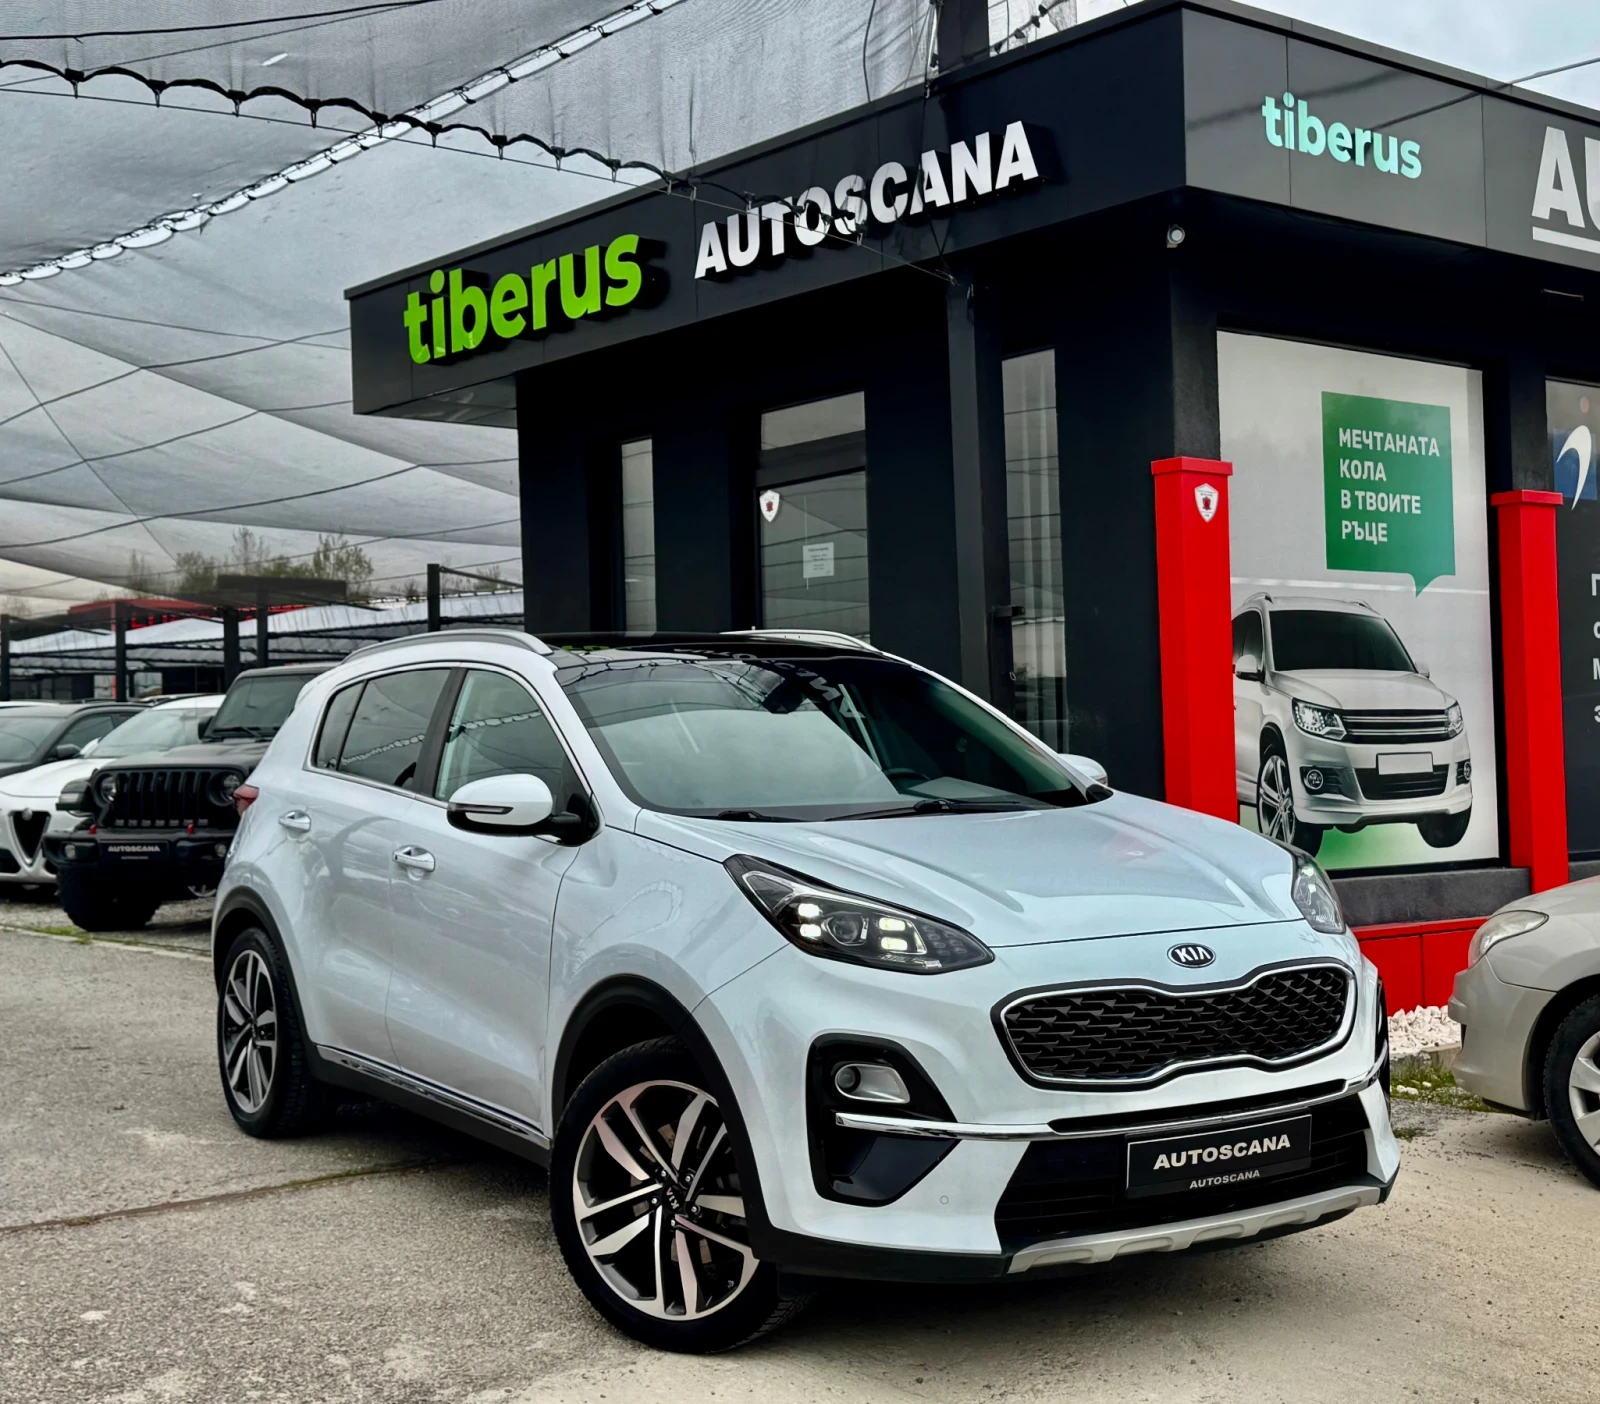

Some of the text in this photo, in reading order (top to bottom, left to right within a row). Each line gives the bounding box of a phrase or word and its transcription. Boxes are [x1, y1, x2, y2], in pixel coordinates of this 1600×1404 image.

[1262, 92, 1422, 179] tiberus
[694, 120, 1038, 279] AUTOSCANA
[403, 234, 643, 365] tiberus
[1339, 428, 1440, 456] МЕЧТАНАТА
[1340, 459, 1386, 481] КОЛА
[1341, 489, 1421, 514] В ТВОИТЕ
[1342, 520, 1387, 545] РЪЦЕ
[1175, 945, 1211, 963] KIA
[1153, 1134, 1290, 1170] AUTOSCANA
[1189, 1169, 1260, 1189] AUTOSCANA
